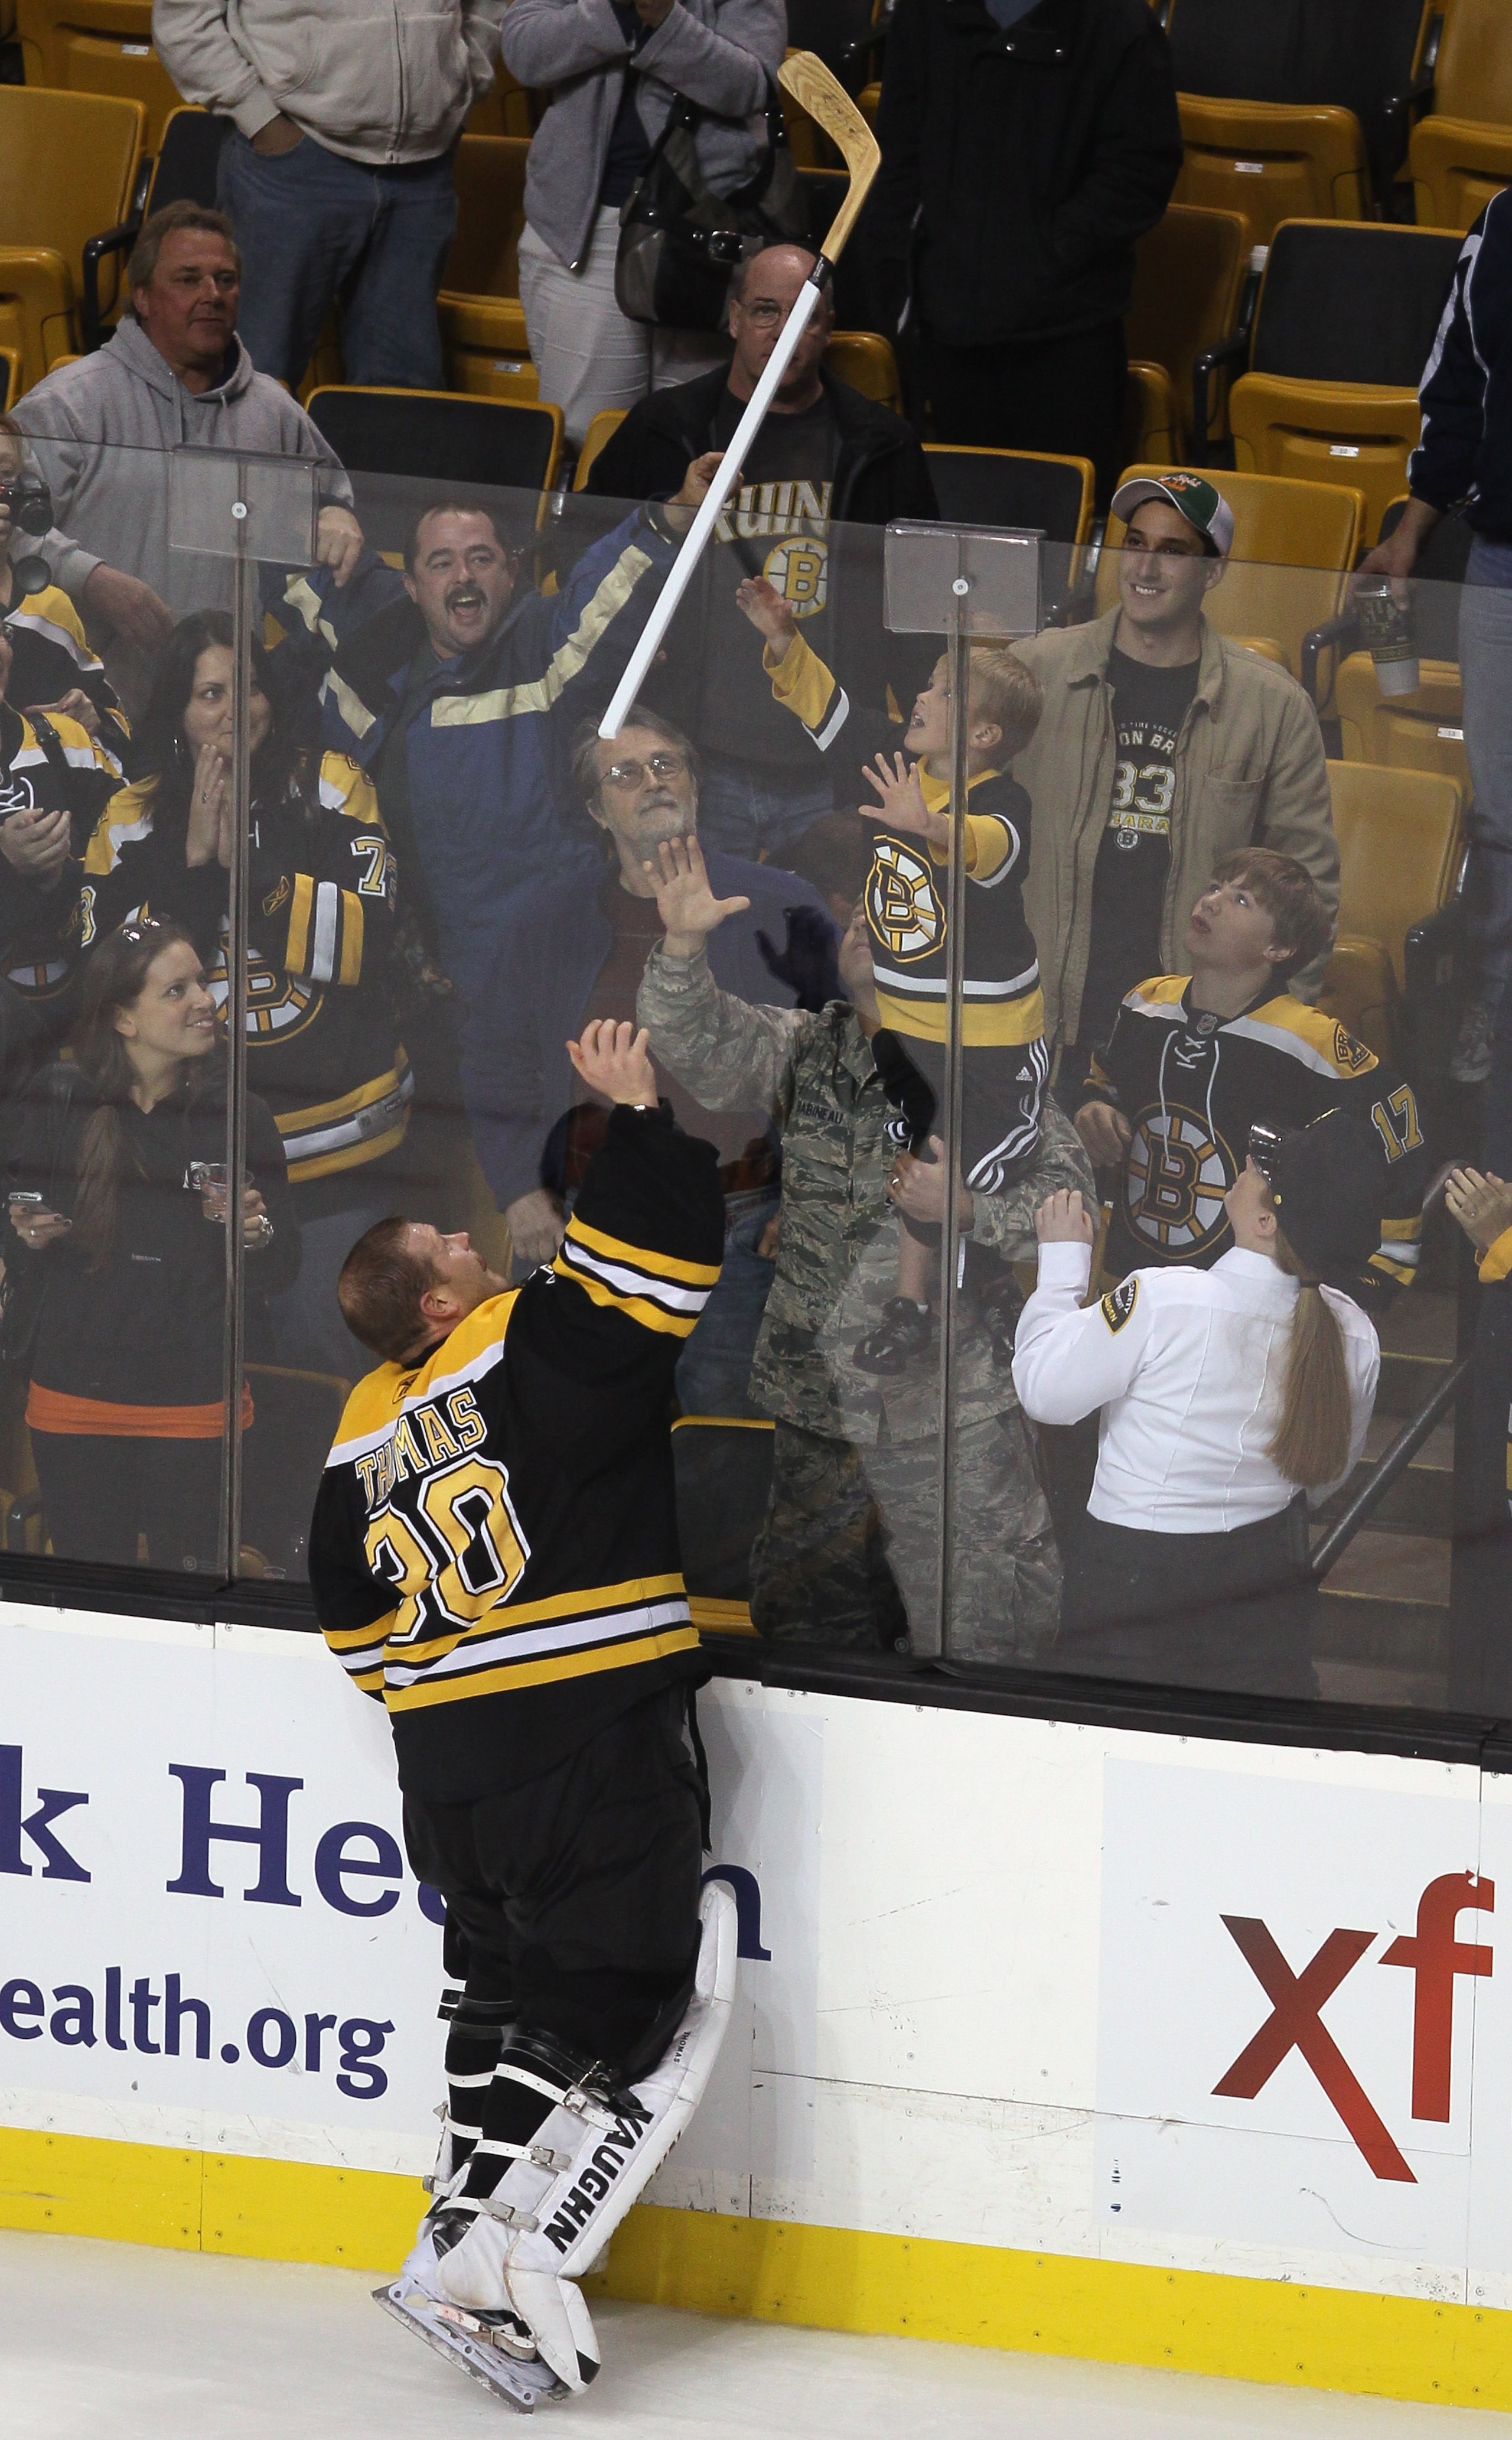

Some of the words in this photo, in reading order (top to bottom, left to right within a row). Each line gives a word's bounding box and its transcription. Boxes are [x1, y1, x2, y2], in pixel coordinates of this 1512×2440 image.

[1371, 1084, 1425, 1164] 17
[364, 1452, 531, 1643] 30
[0, 1966, 395, 2100] ealth.org
[673, 2031, 692, 2064] THOMAS
[1210, 1869, 1495, 2184] xf
[543, 2109, 654, 2254] VAUGHN
